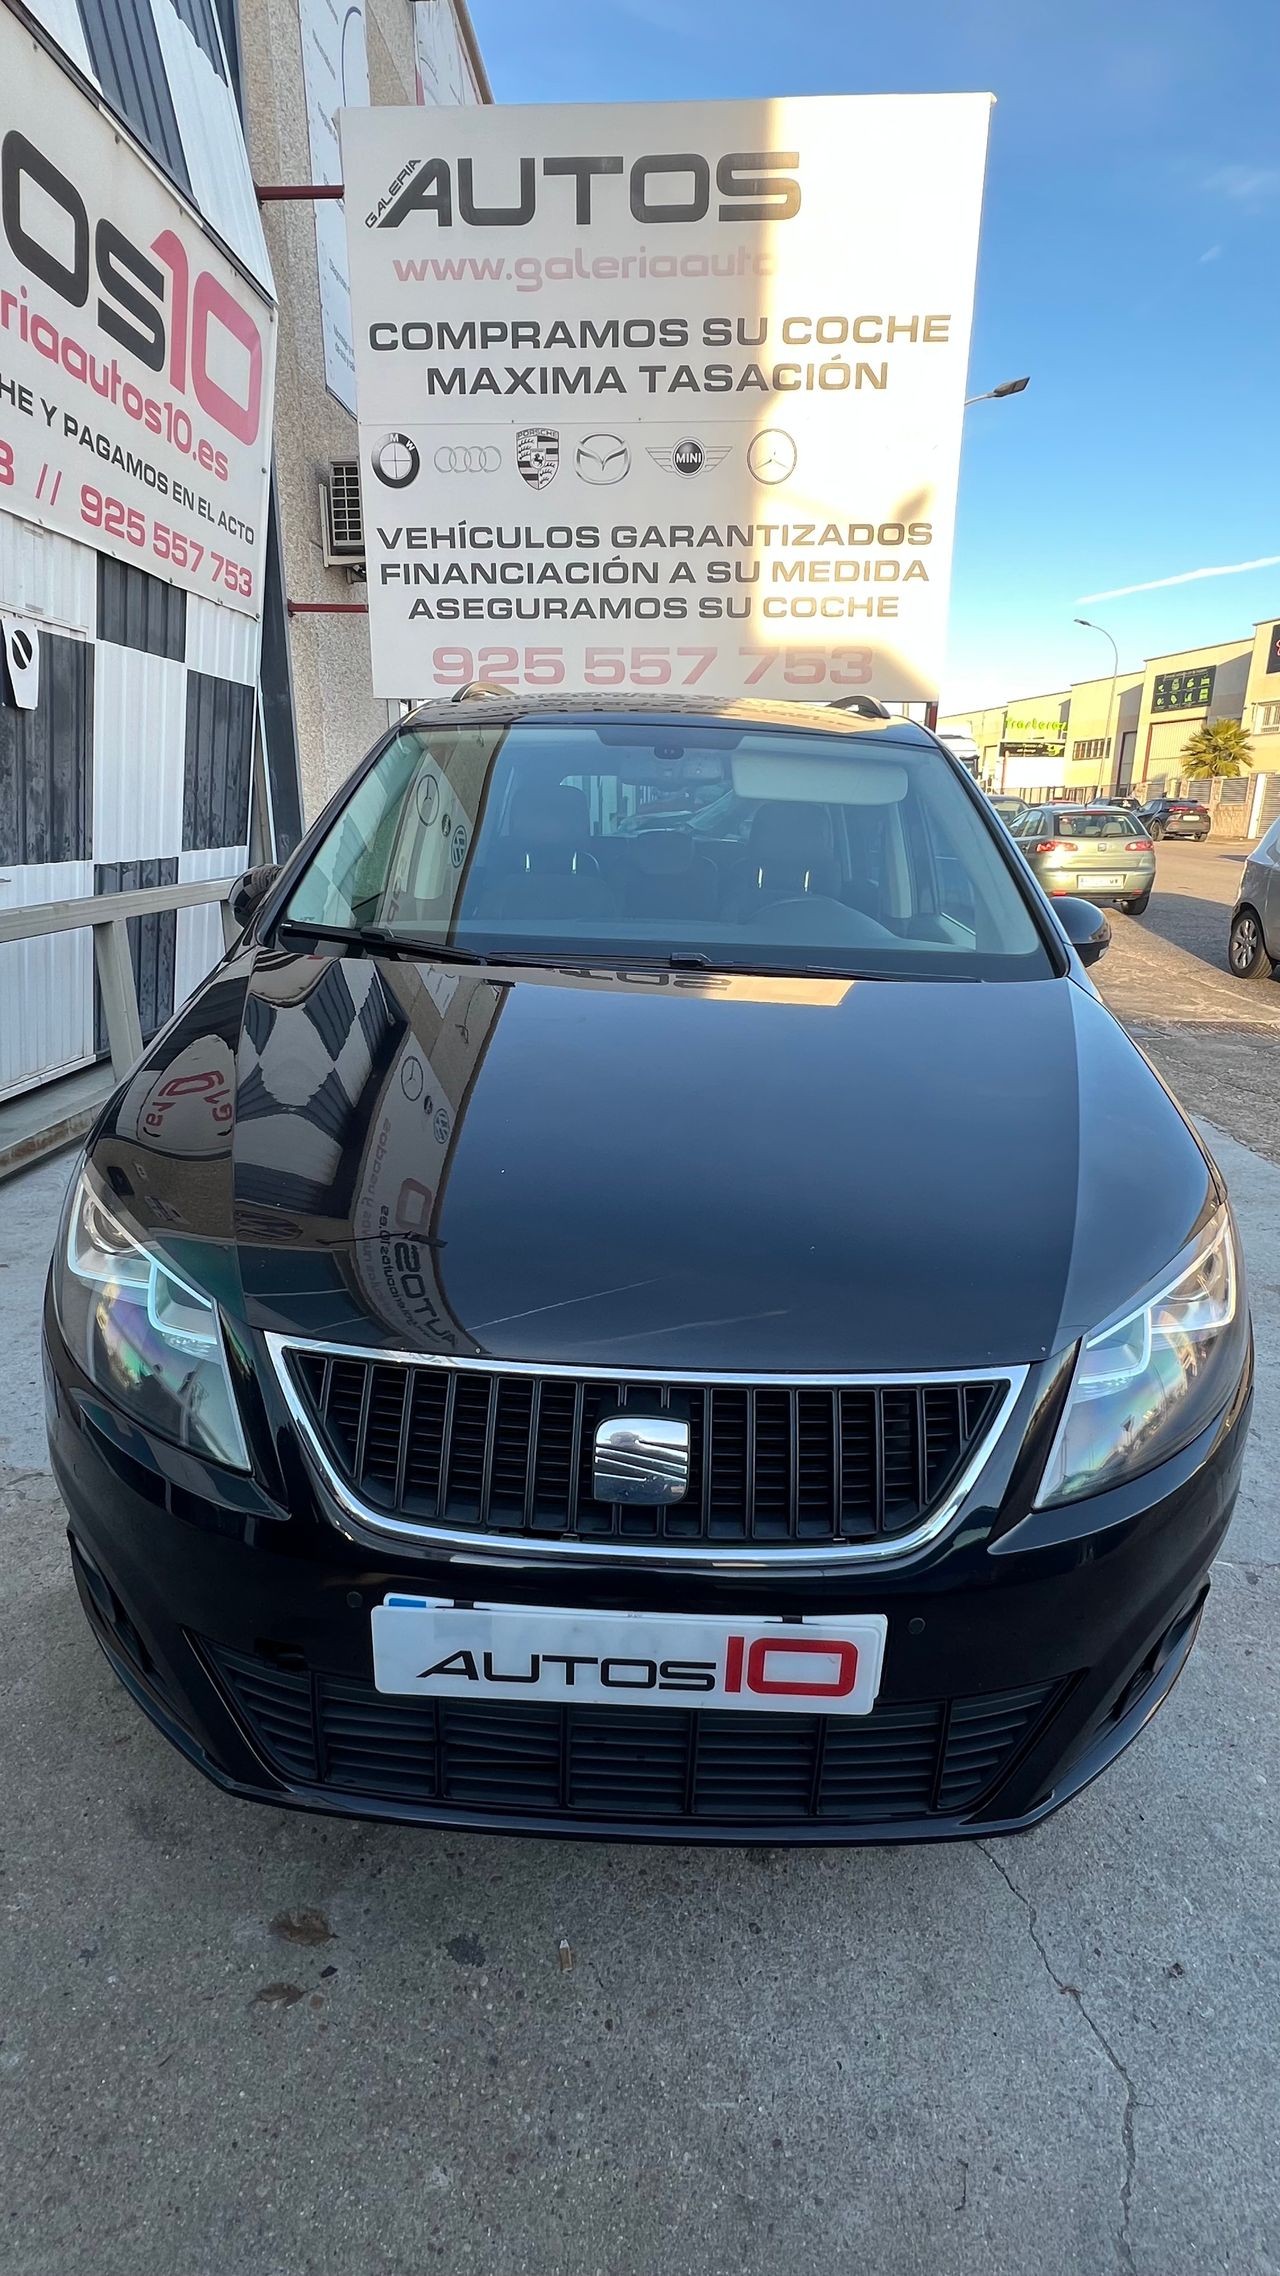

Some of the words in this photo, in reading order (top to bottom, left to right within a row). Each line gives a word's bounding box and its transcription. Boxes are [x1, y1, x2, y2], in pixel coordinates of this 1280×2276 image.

[365, 160, 422, 228] GALERIA
[377, 152, 801, 229] AUTOS
[369, 319, 689, 352] COMPRAMOS
[703, 318, 768, 347] SU
[783, 315, 951, 345] COCHE
[427, 366, 627, 396] MAXIMA
[639, 354, 888, 393] TASACIÓN
[40, 397, 58, 427] Y
[64, 412, 169, 495] PAGAMOS
[173, 480, 195, 511] EN
[198, 496, 215, 523] EL
[217, 510, 255, 545] ACTO
[676, 452, 702, 464] MINI
[80, 484, 146, 548] 925
[153, 521, 205, 573] 557
[210, 551, 253, 598] 753
[376, 520, 600, 550] VEHÍCULOS
[611, 522, 933, 549] GARANTIZADOS
[381, 555, 659, 585] FINANCIACIÓN
[669, 562, 697, 584] A
[707, 561, 761, 583] SU
[772, 560, 929, 583] MEDIDA
[408, 597, 688, 620] ASEGURAMOS
[698, 597, 752, 619] SU
[763, 596, 899, 618] COCHE
[432, 646, 565, 686] 925
[584, 646, 719, 685] 557
[739, 645, 874, 684] 753
[416, 1636, 858, 1696] AUTOS10
